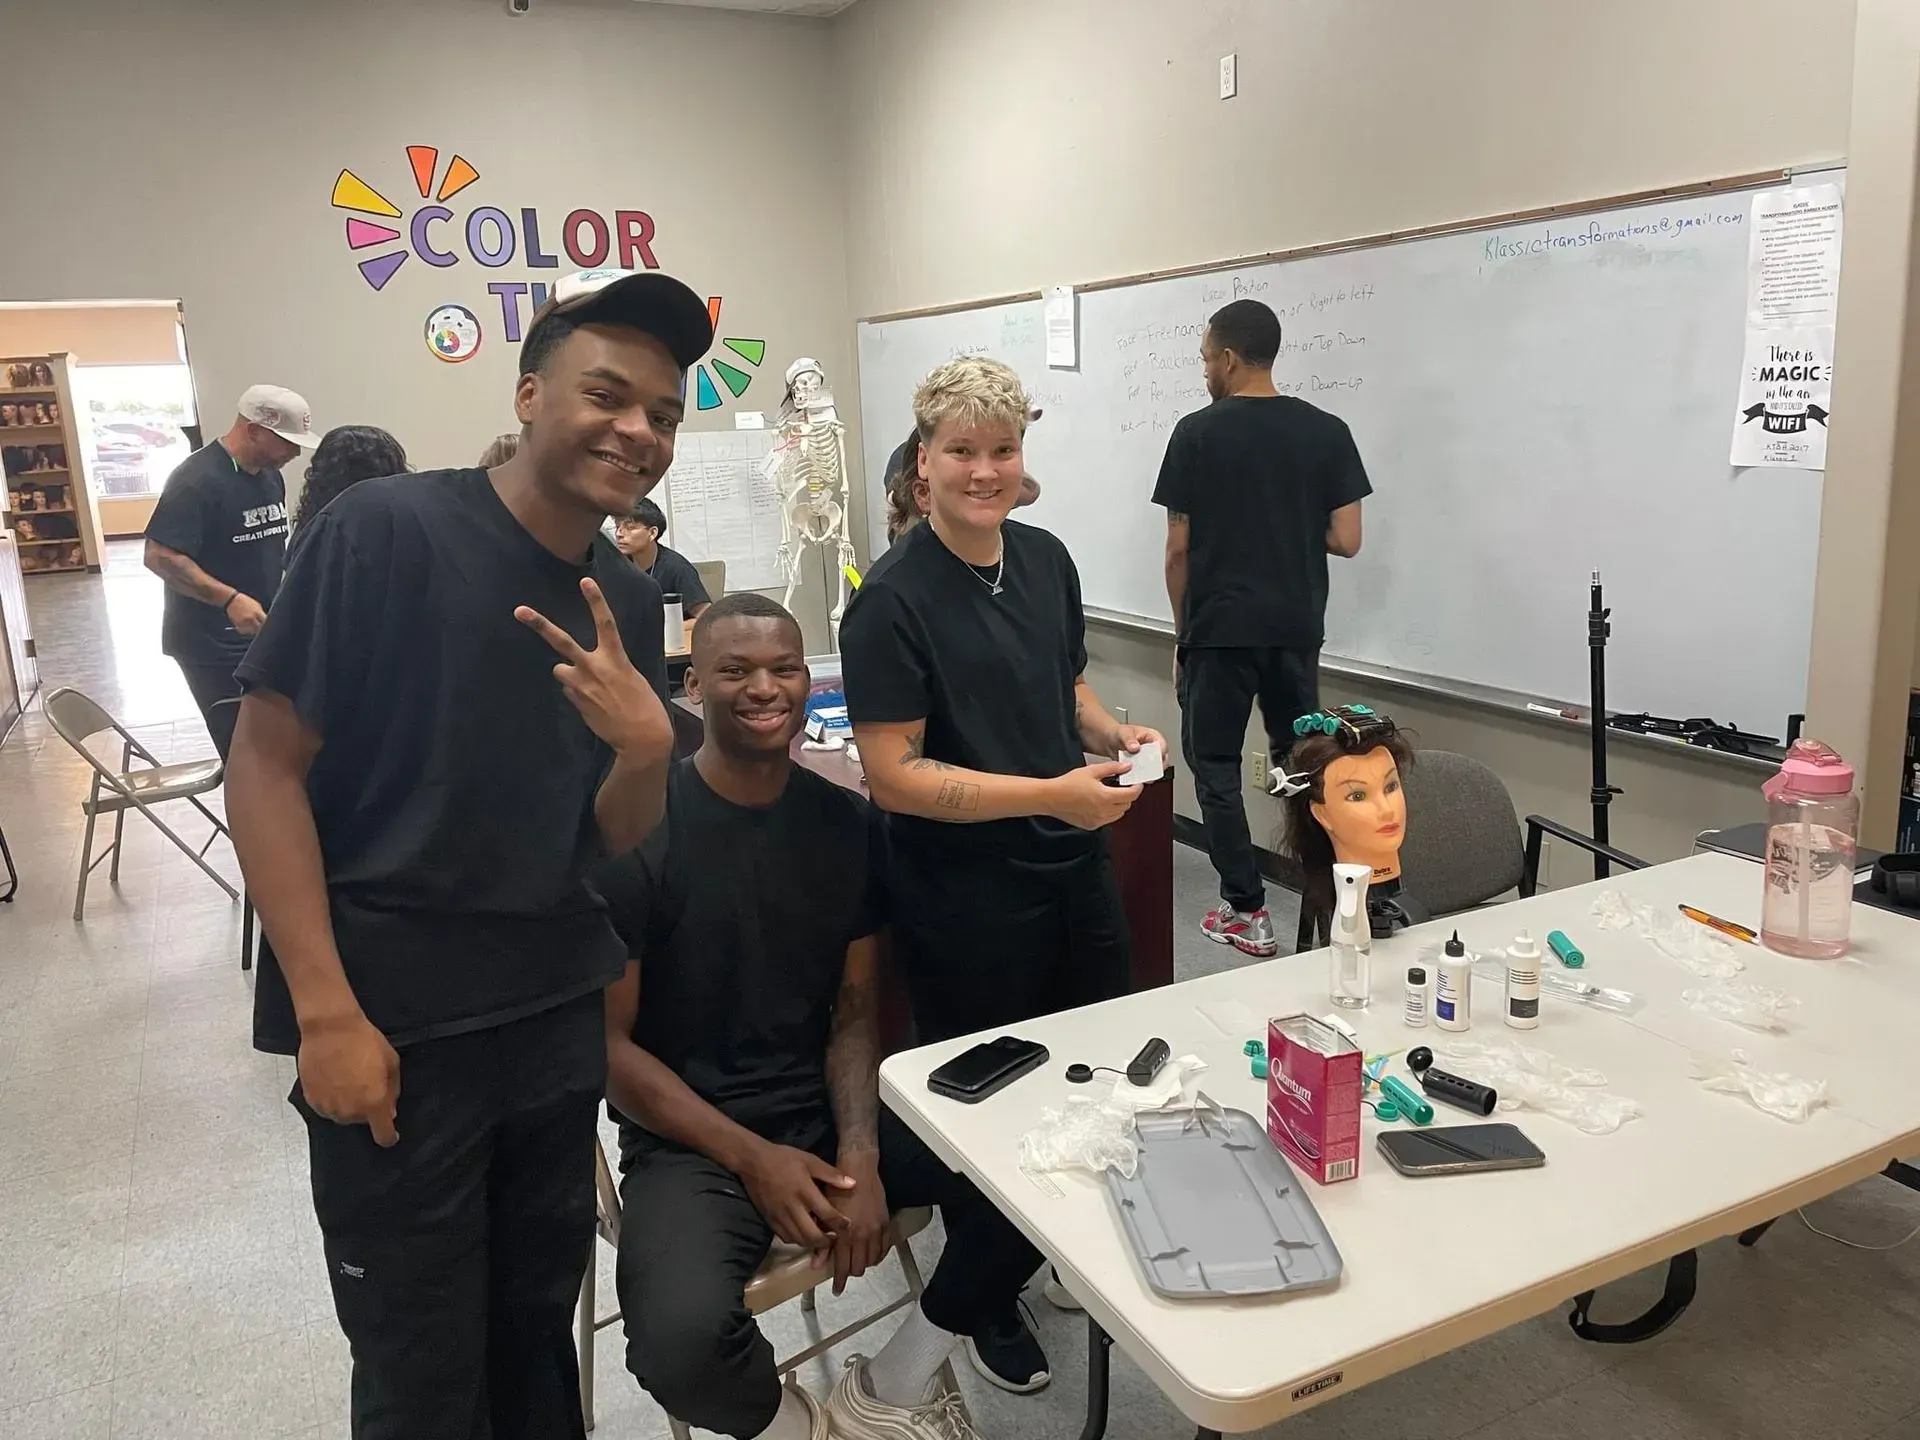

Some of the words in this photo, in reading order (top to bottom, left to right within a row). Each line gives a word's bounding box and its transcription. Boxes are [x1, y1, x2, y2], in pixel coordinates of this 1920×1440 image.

[409, 205, 661, 270] COLOR
[1766, 344, 1801, 362] There
[1759, 366, 1820, 382] MAGIC
[1768, 416, 1802, 431] WIFI
[1270, 1057, 1313, 1108] Quantum
